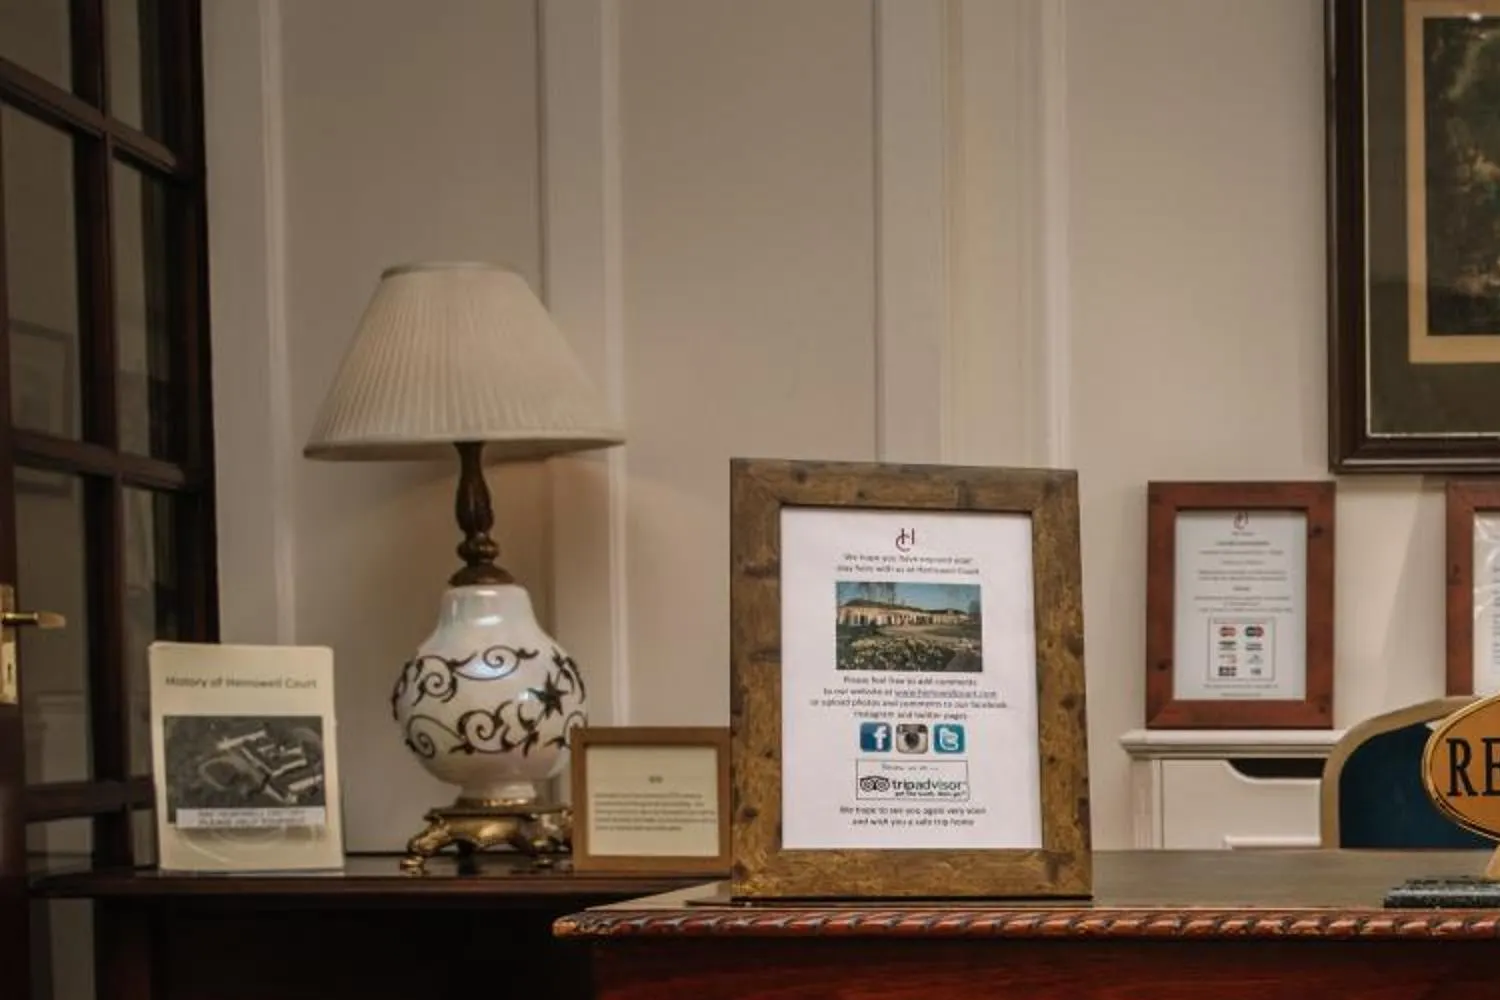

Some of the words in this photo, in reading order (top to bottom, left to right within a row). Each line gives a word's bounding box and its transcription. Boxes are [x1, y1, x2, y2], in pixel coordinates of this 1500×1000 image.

[165, 676, 206, 688] History
[210, 676, 223, 688] of
[285, 677, 317, 689] Court
[892, 778, 962, 792] tripadvisor
